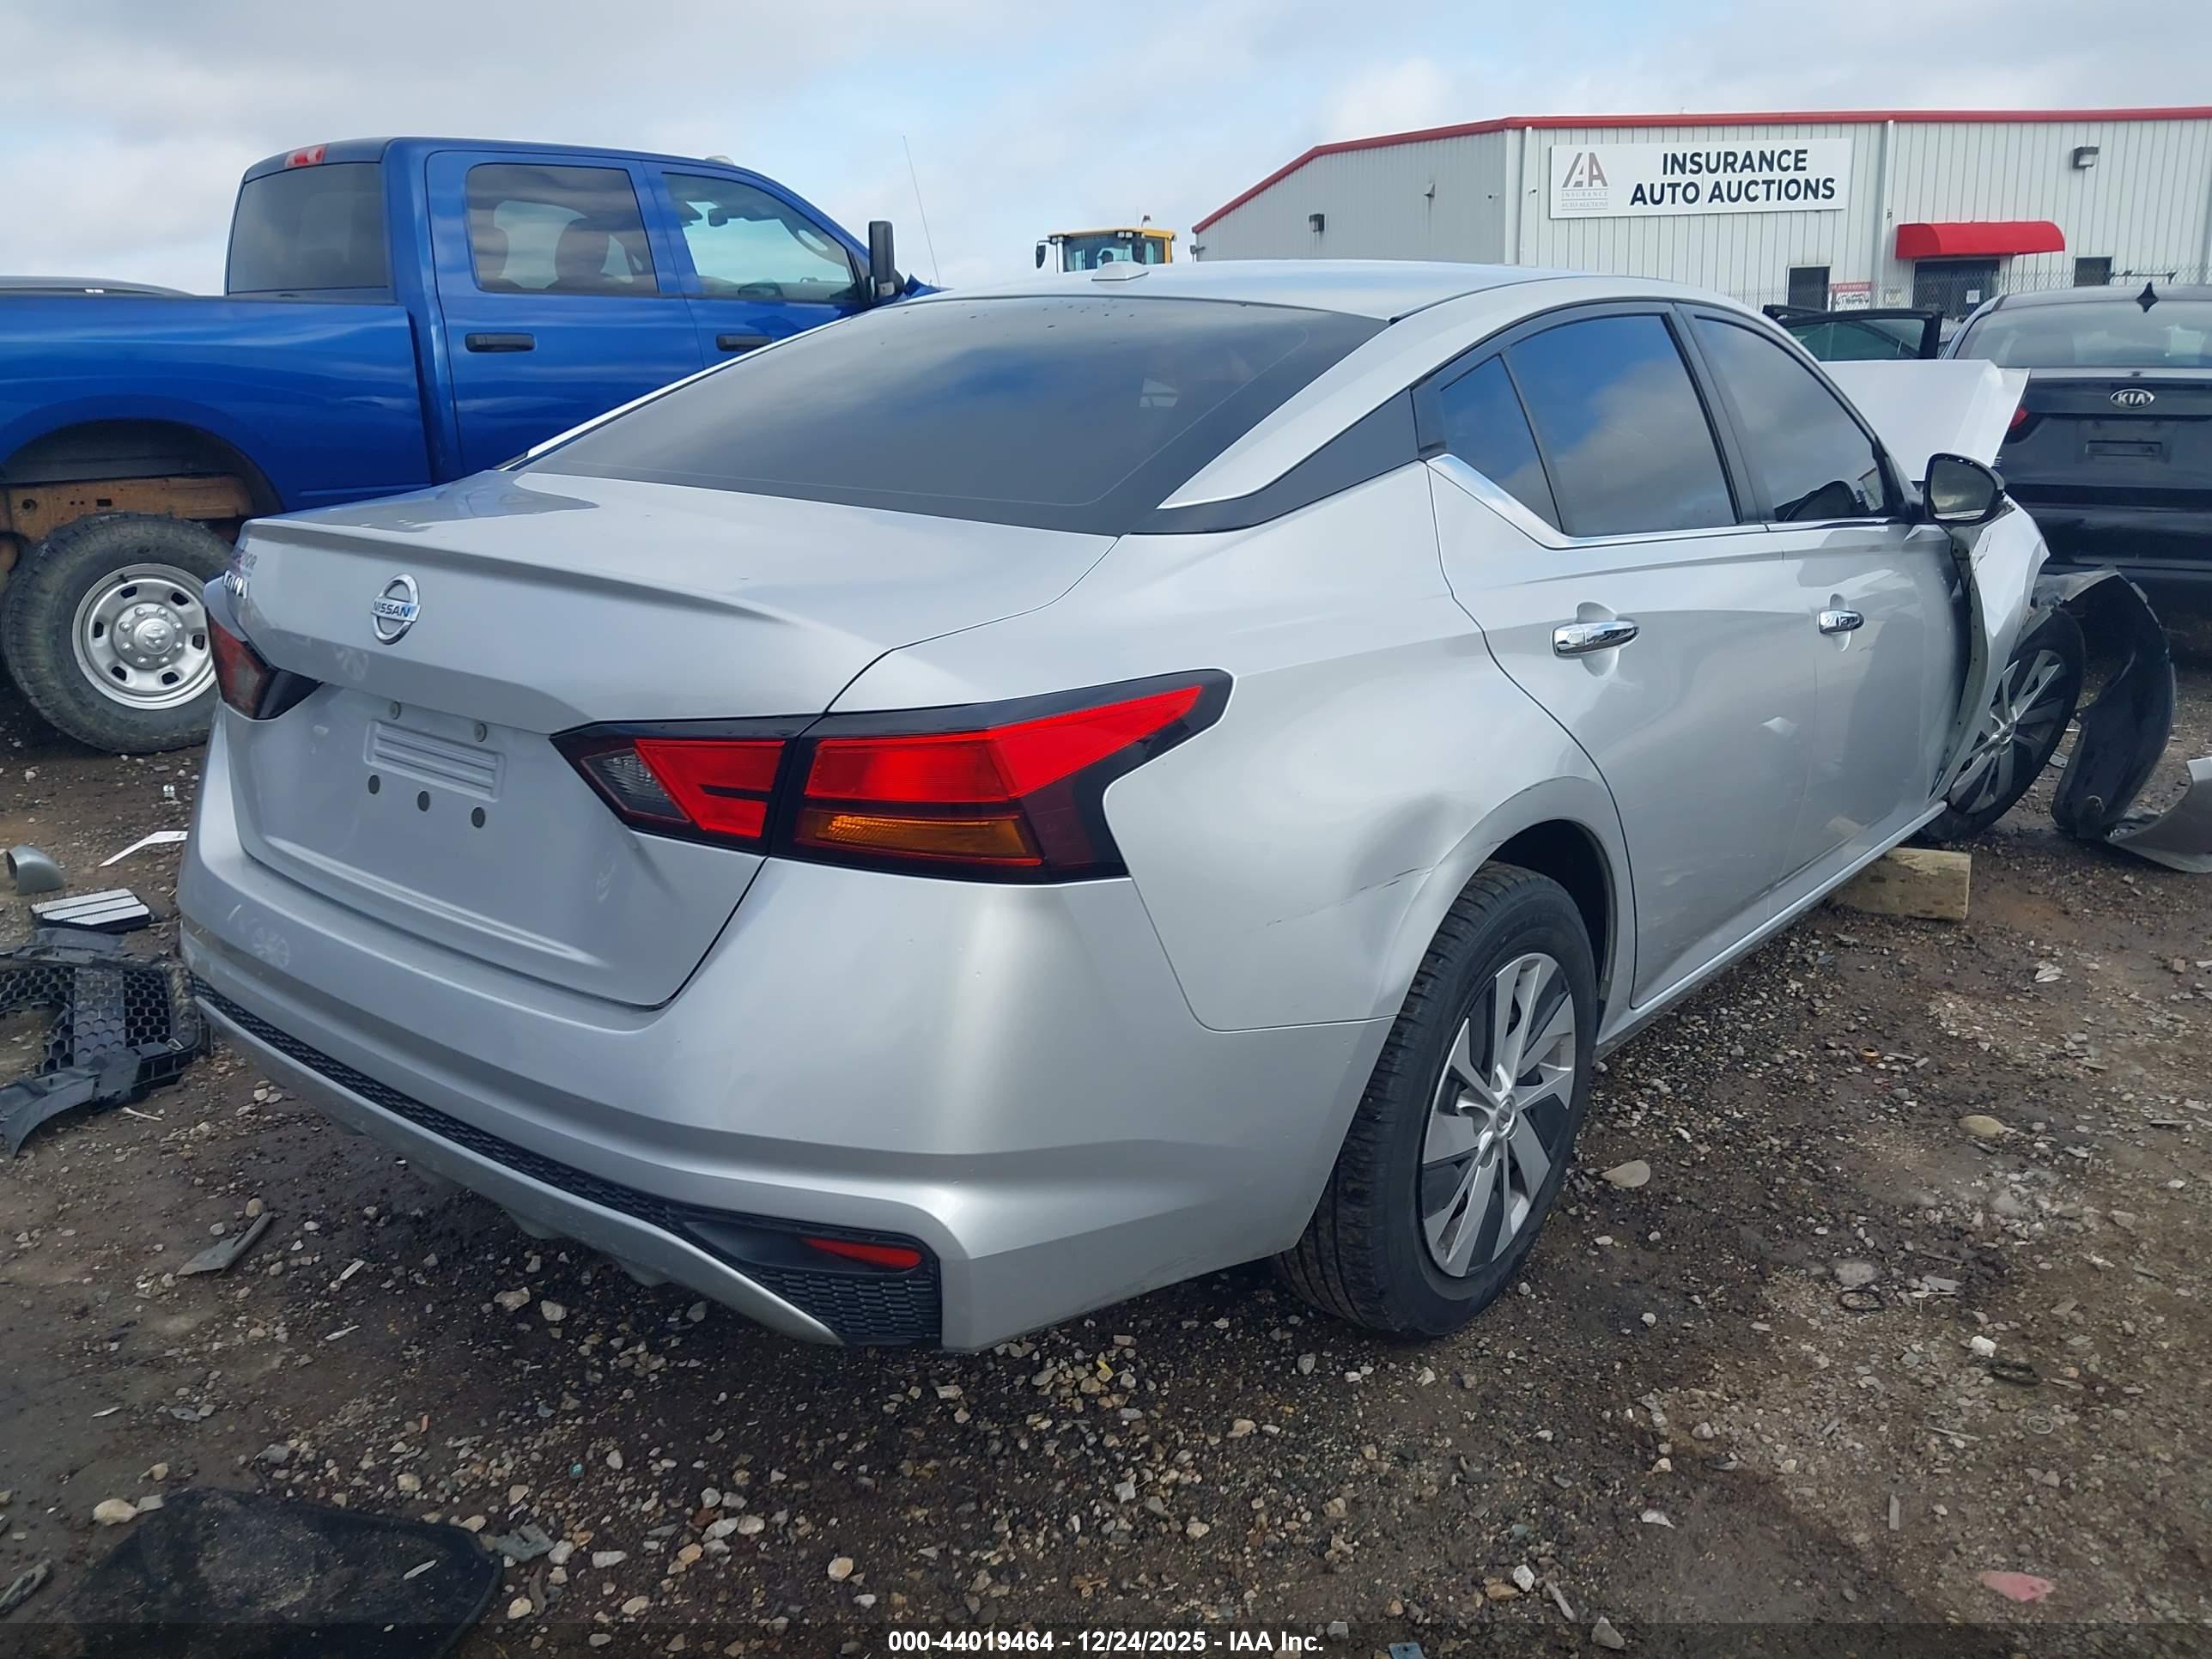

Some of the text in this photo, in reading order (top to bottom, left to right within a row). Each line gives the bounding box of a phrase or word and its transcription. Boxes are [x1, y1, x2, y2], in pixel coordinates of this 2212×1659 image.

[1662, 149, 1808, 176] INSURANCE
[1630, 177, 1836, 206] AUTO AUCTIONS
[2117, 392, 2146, 405] KIA
[373, 600, 412, 618] NISSAN
